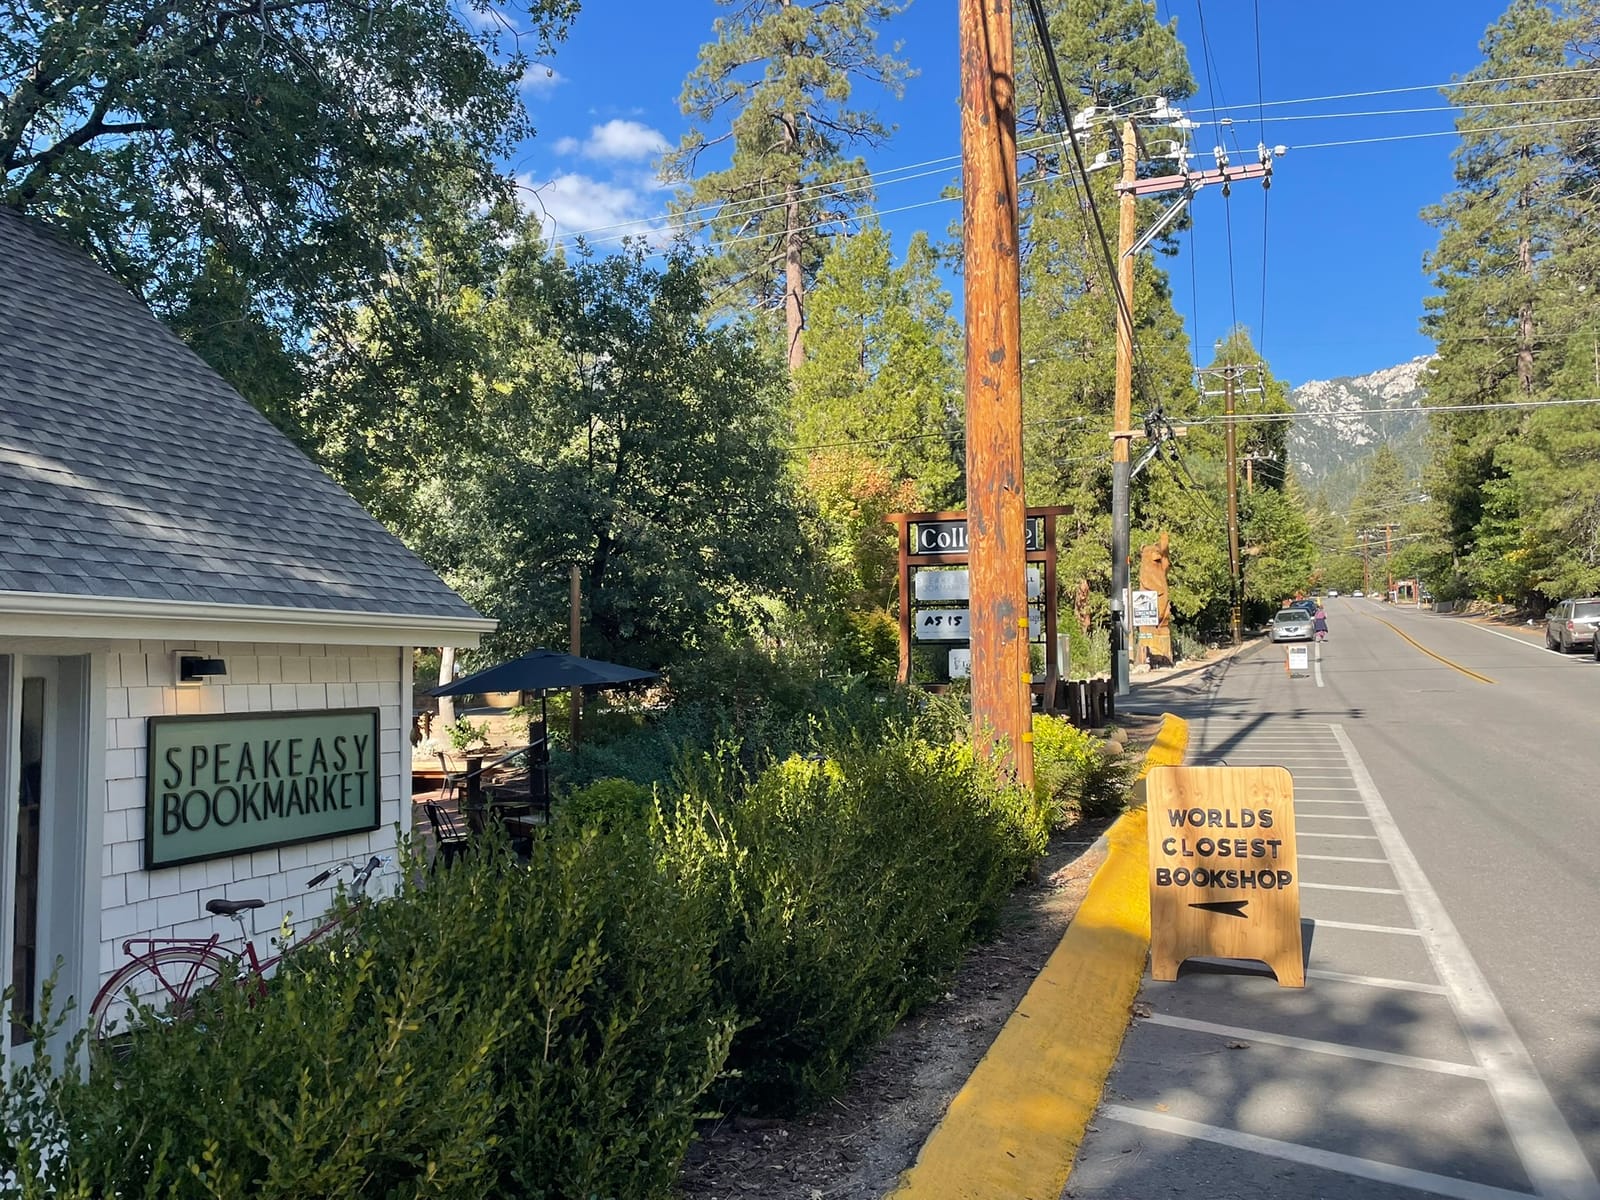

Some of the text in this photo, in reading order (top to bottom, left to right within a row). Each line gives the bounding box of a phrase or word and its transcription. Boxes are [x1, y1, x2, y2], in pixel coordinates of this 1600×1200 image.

[924, 615, 943, 626] AS
[163, 734, 369, 790] SPEAKEASY
[162, 771, 369, 836] BOOKMARKET
[1168, 808, 1274, 829] WORLDS
[1162, 837, 1282, 859] CLOSEST
[1156, 867, 1293, 890] BOOKSHOP
